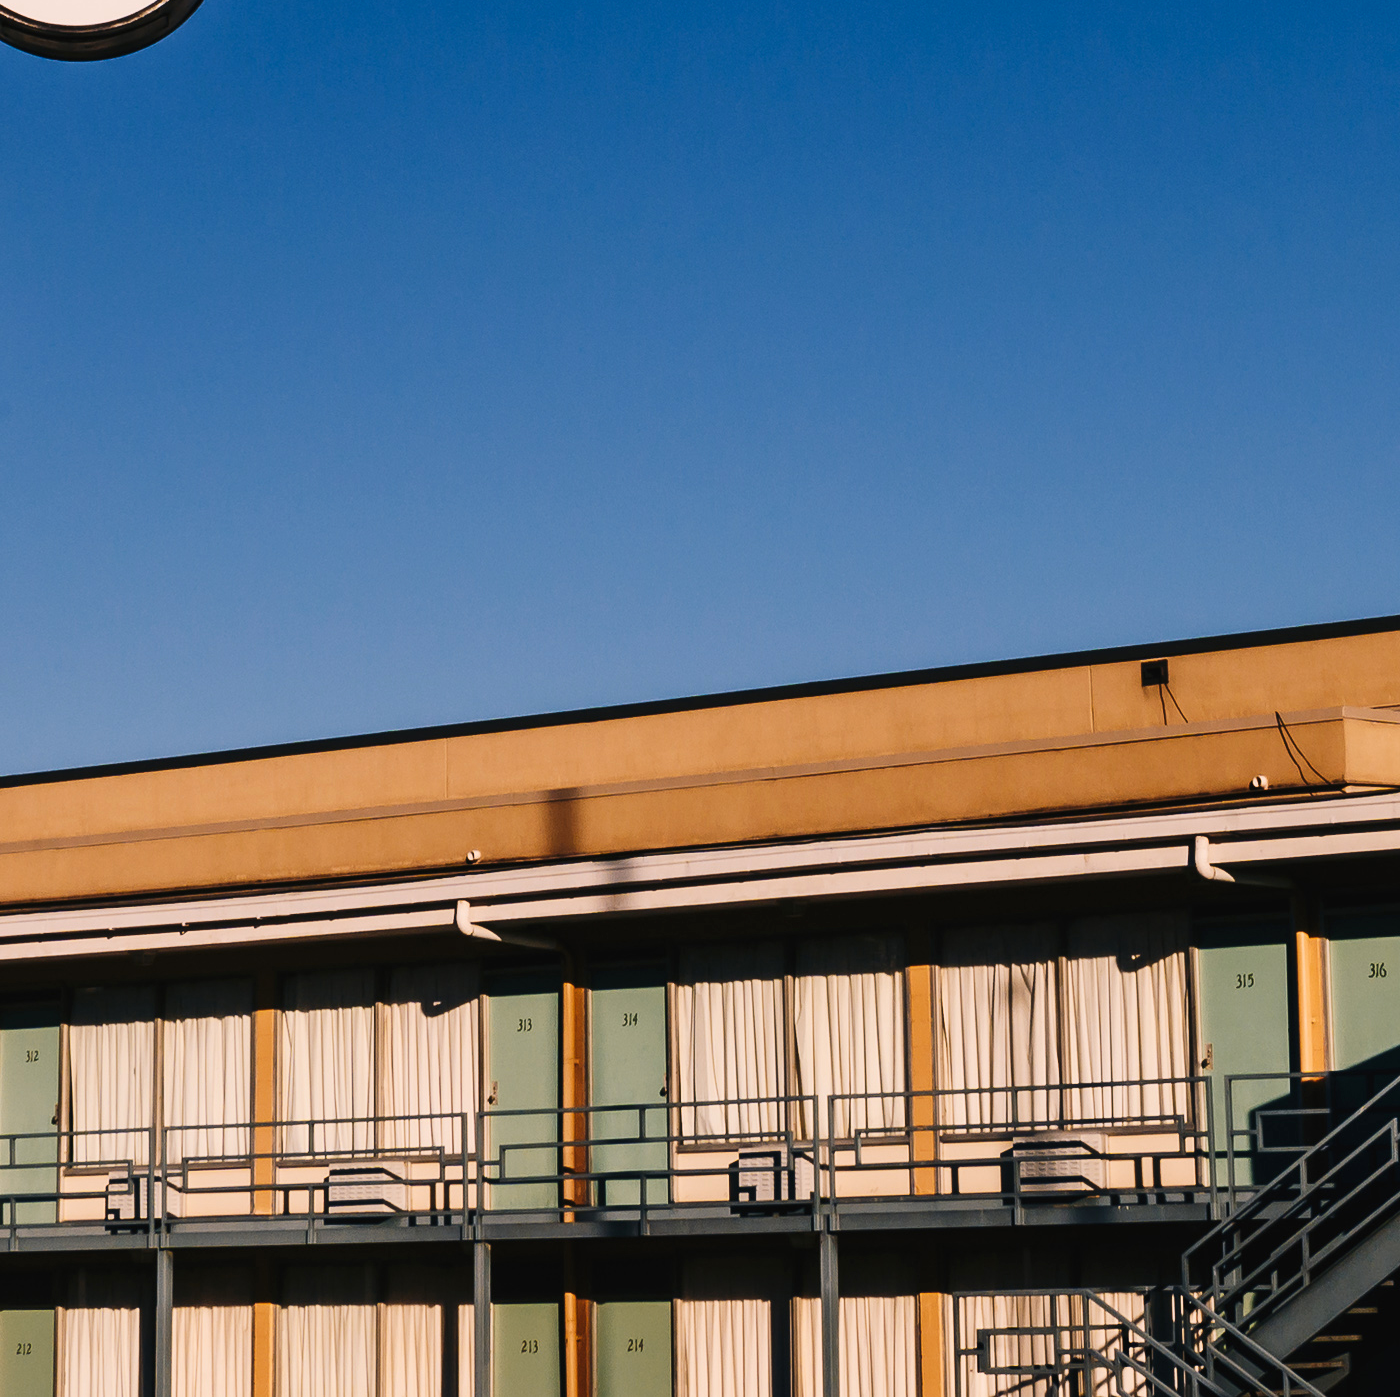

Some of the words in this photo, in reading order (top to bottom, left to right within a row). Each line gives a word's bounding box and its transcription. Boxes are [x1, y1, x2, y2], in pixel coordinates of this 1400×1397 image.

[1368, 962, 1388, 978] 316
[1235, 972, 1255, 989] 315
[517, 1018, 533, 1032] 313
[622, 1012, 638, 1027] 314
[25, 1050, 39, 1063] 312
[16, 1342, 32, 1355] 212
[520, 1339, 539, 1354] 213
[627, 1338, 644, 1353] 214
